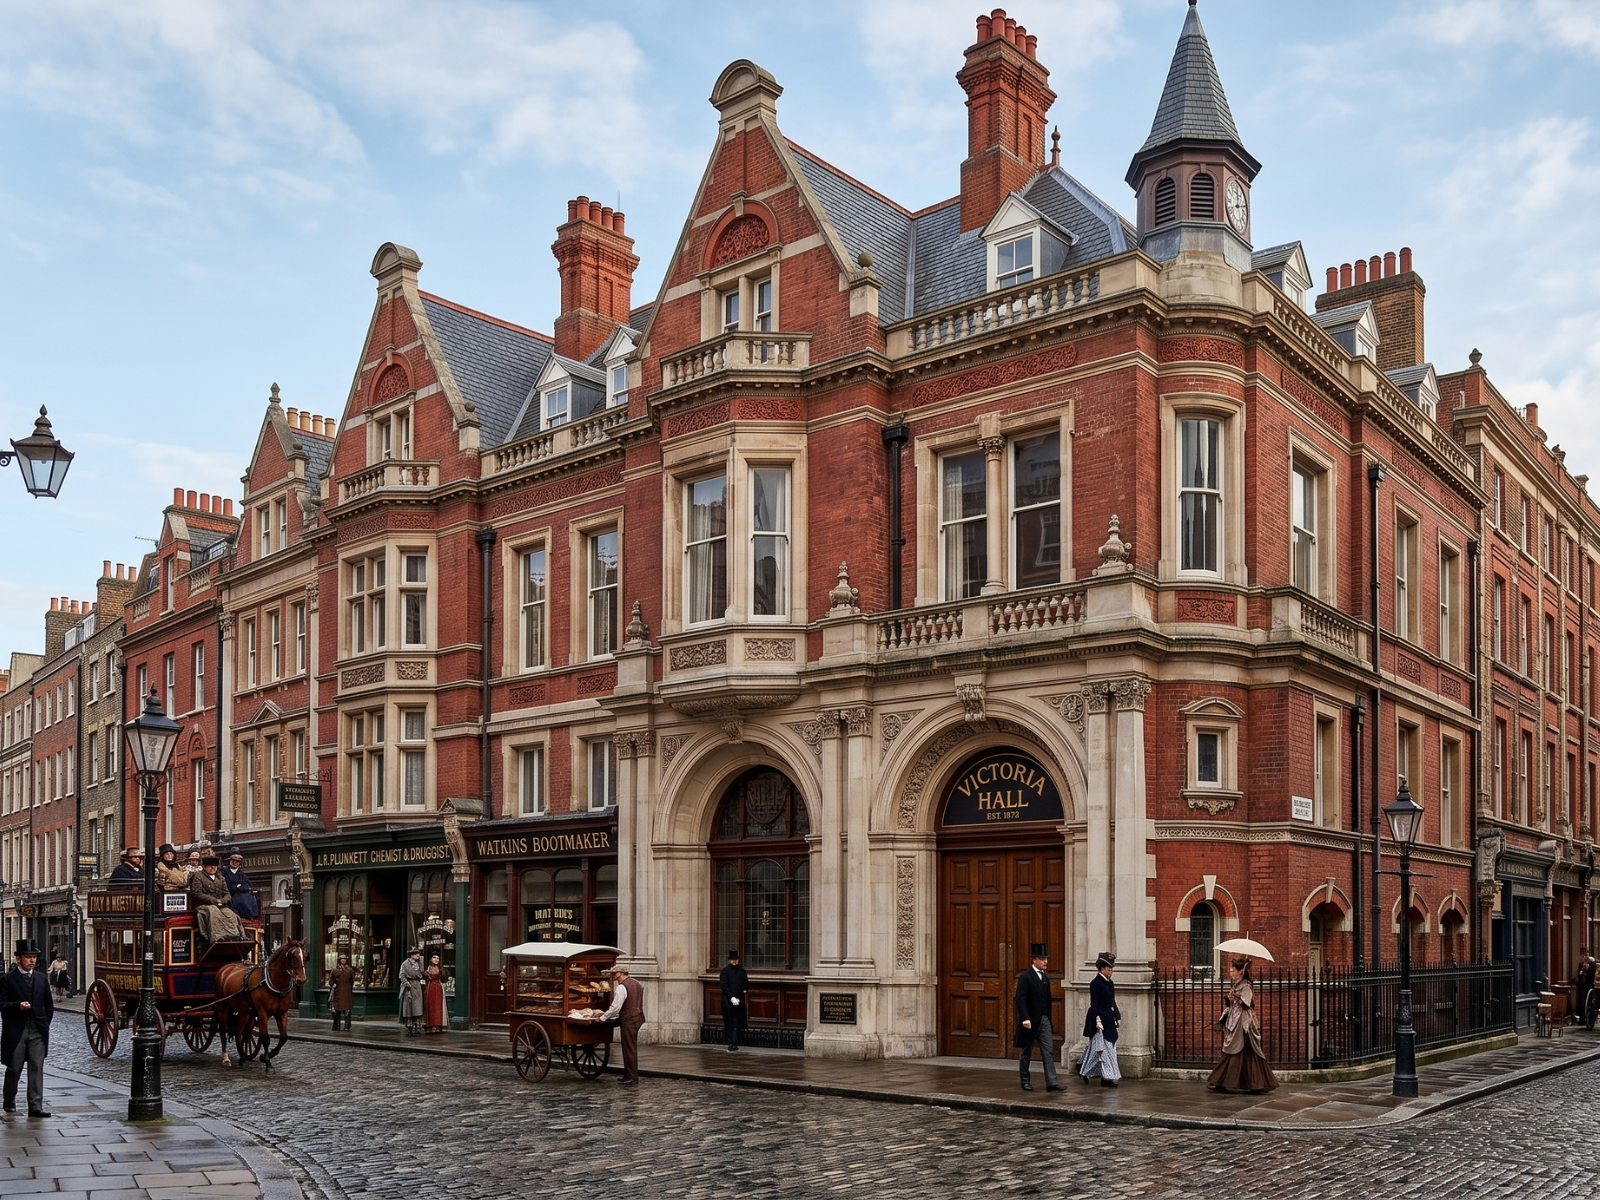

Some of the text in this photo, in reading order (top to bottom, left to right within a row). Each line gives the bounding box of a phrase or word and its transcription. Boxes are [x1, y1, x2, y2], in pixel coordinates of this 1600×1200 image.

[957, 762, 1046, 797] VICTORIA
[978, 790, 1030, 810] HALL
[987, 812, 1002, 820] EST.
[477, 832, 610, 856] WATKINS BOOTMAKER
[330, 851, 368, 866] PLUNKETT
[371, 848, 402, 863] CHEMIST
[403, 848, 410, 861] &
